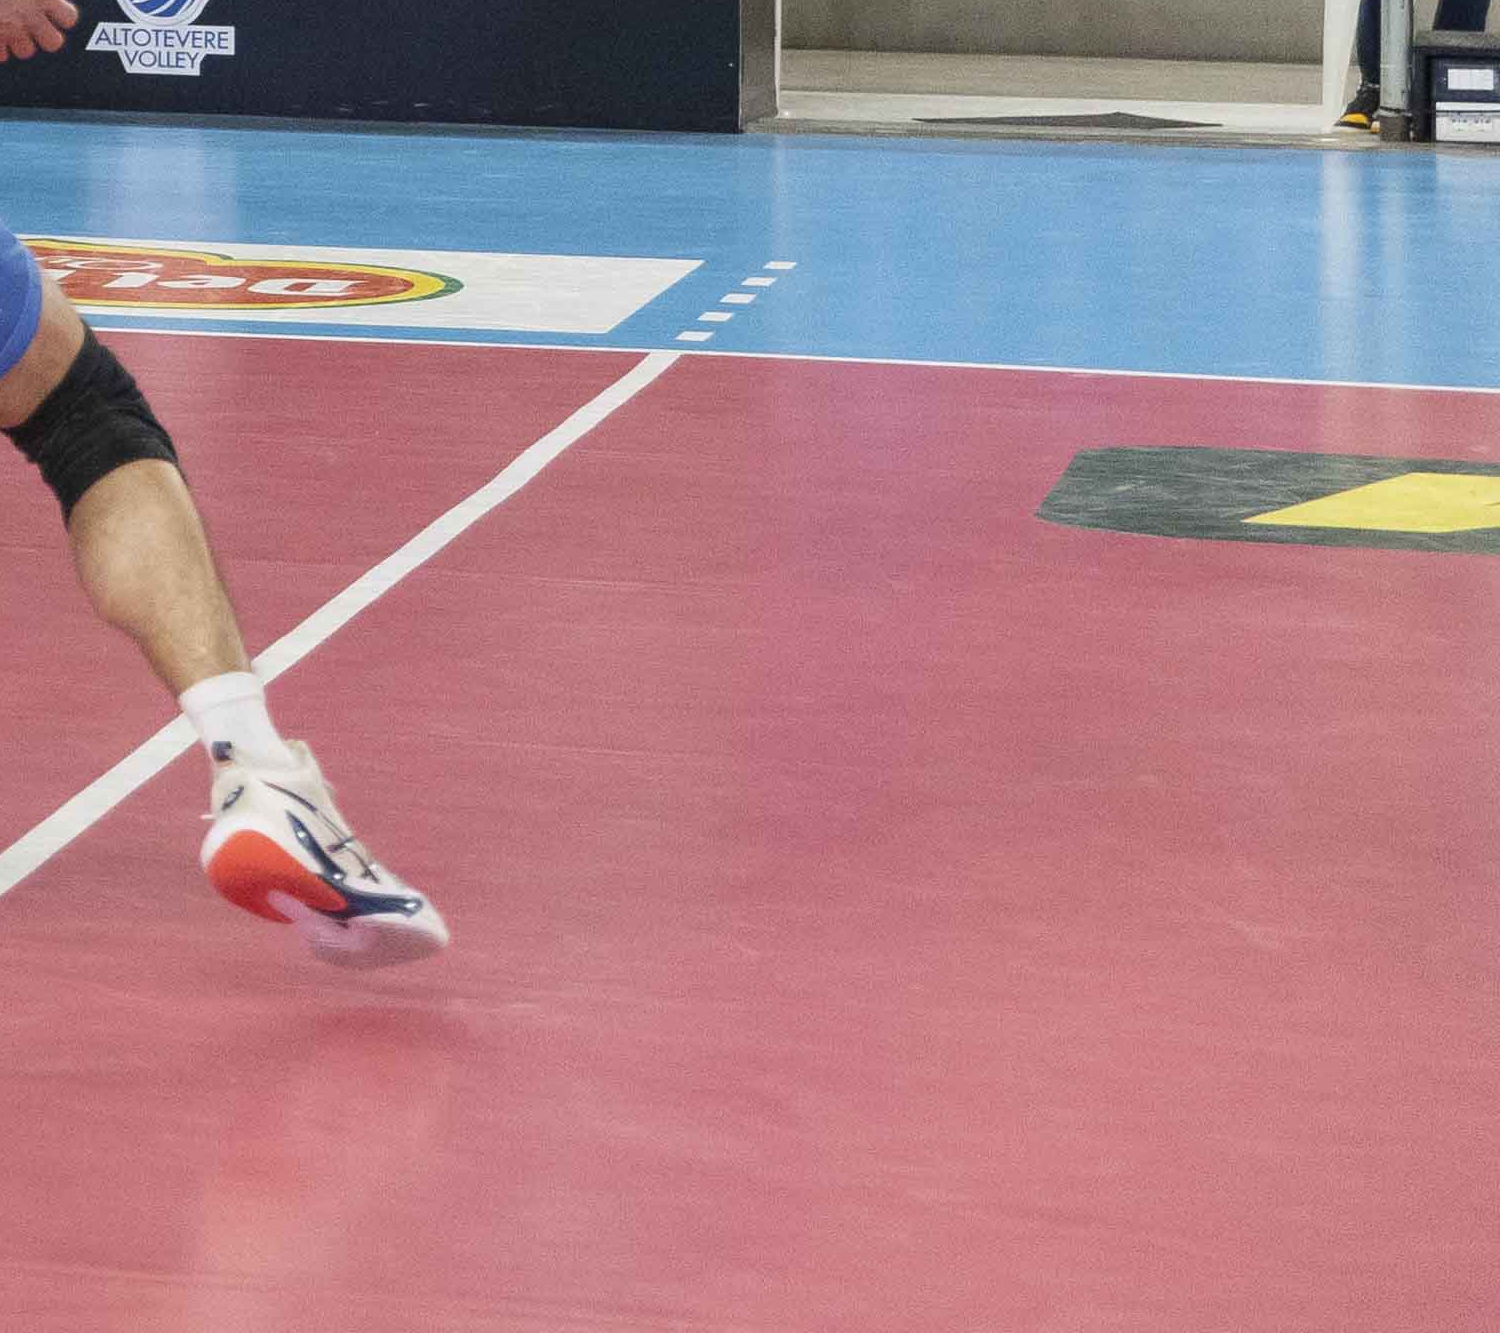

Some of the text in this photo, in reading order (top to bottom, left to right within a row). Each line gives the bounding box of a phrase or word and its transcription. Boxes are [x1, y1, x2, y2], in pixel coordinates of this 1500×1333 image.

[95, 27, 229, 49] ALTOTEVERE
[124, 50, 200, 70] VOLLEY
[102, 271, 372, 297] Del
